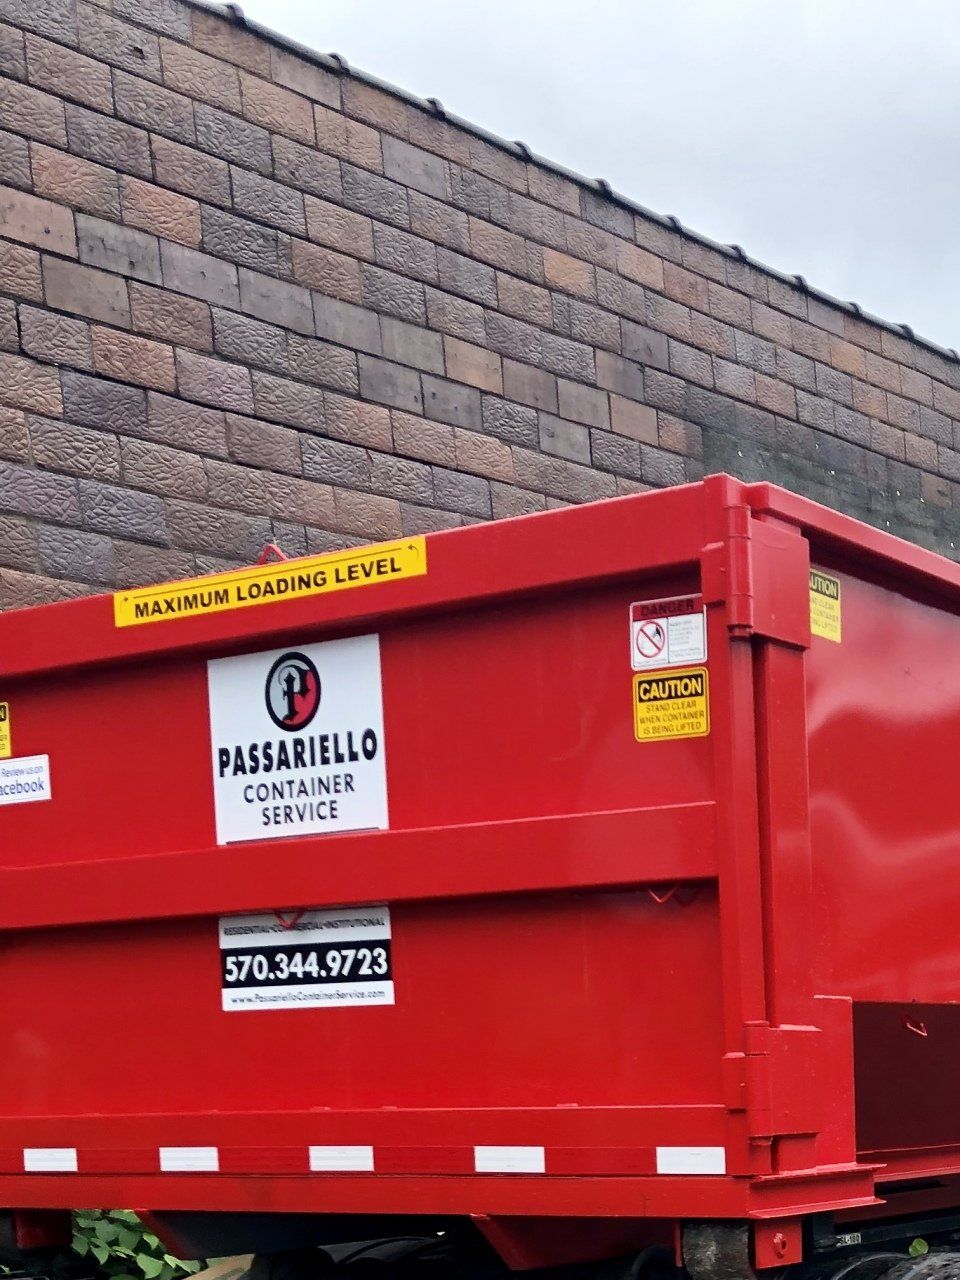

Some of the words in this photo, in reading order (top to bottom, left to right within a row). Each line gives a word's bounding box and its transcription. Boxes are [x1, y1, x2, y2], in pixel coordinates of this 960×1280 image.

[135, 589, 230, 619] MAXIMUM
[236, 572, 327, 602] LOADING
[335, 557, 402, 584] LEVEL
[810, 574, 837, 597] UTION
[641, 599, 694, 617] DANGER
[639, 677, 702, 700] CAUTION
[640, 714, 660, 724] WHEN
[662, 710, 704, 722] CONTAINER
[646, 703, 670, 713] STAND
[672, 700, 697, 710] CLEAR
[652, 724, 674, 734] BEING
[676, 721, 701, 732] LIFTED
[218, 728, 377, 779] PASSARIELLO
[1, 768, 24, 778] Review
[0, 777, 45, 796] acebook
[243, 774, 355, 804] CONTAINER
[262, 799, 338, 826] SERVICE
[271, 920, 323, 933] COERCIAL
[225, 947, 388, 982] 570.344.9723
